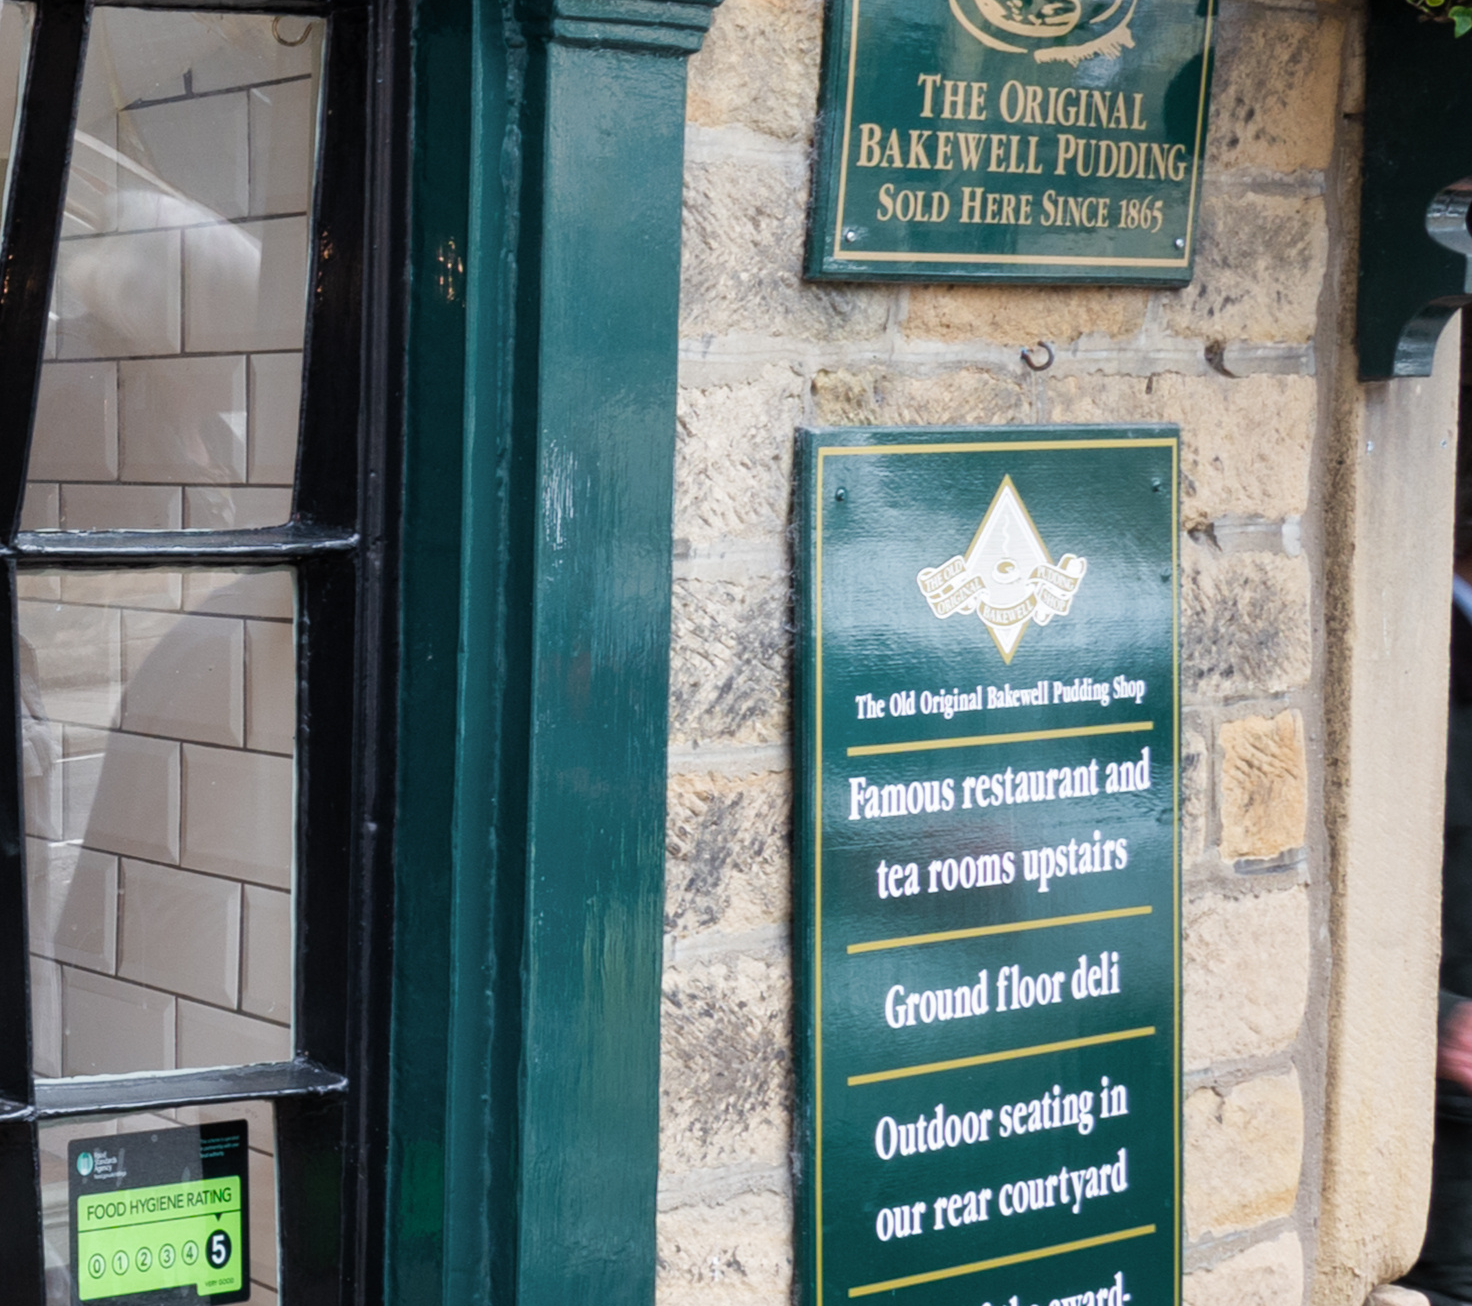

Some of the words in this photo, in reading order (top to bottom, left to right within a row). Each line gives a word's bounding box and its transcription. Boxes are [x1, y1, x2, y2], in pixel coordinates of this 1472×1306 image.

[918, 74, 987, 120] THE
[1000, 80, 1145, 129] ORIGINAL
[857, 124, 1042, 173] BAKEWELL
[1055, 134, 1186, 181] PUDDING
[877, 184, 949, 222] SOLD
[960, 187, 1032, 224] HERE
[1041, 192, 1109, 227] SINCE
[1118, 198, 1162, 233] 1865
[937, 577, 981, 614] ORIGINAL
[984, 600, 1033, 624] BAKEWELL
[856, 693, 885, 719] The
[890, 690, 916, 716] Old
[920, 685, 982, 719] Original
[987, 681, 1049, 709] Bakewell
[1053, 678, 1110, 706] Pudding
[1113, 675, 1145, 704] Shop
[848, 777, 955, 820] Famous
[962, 759, 1099, 809] restaurant
[1105, 747, 1151, 794] and
[877, 860, 920, 898] tea
[928, 852, 1015, 892] rooms
[1022, 830, 1127, 892] upstairs
[885, 969, 989, 1028] Ground
[996, 965, 1065, 1012] floor
[1072, 951, 1120, 999] deli
[875, 1104, 993, 1160] Outdoor
[1000, 1085, 1093, 1137] seating
[1100, 1077, 1128, 1118] in
[87, 1202, 126, 1220] FOOD
[130, 1193, 184, 1214] HYGIENE
[187, 1187, 232, 1206] RATING
[876, 1202, 926, 1241] our
[934, 1189, 992, 1230] rear
[999, 1148, 1127, 1216] courtyard
[212, 1234, 226, 1264] 5
